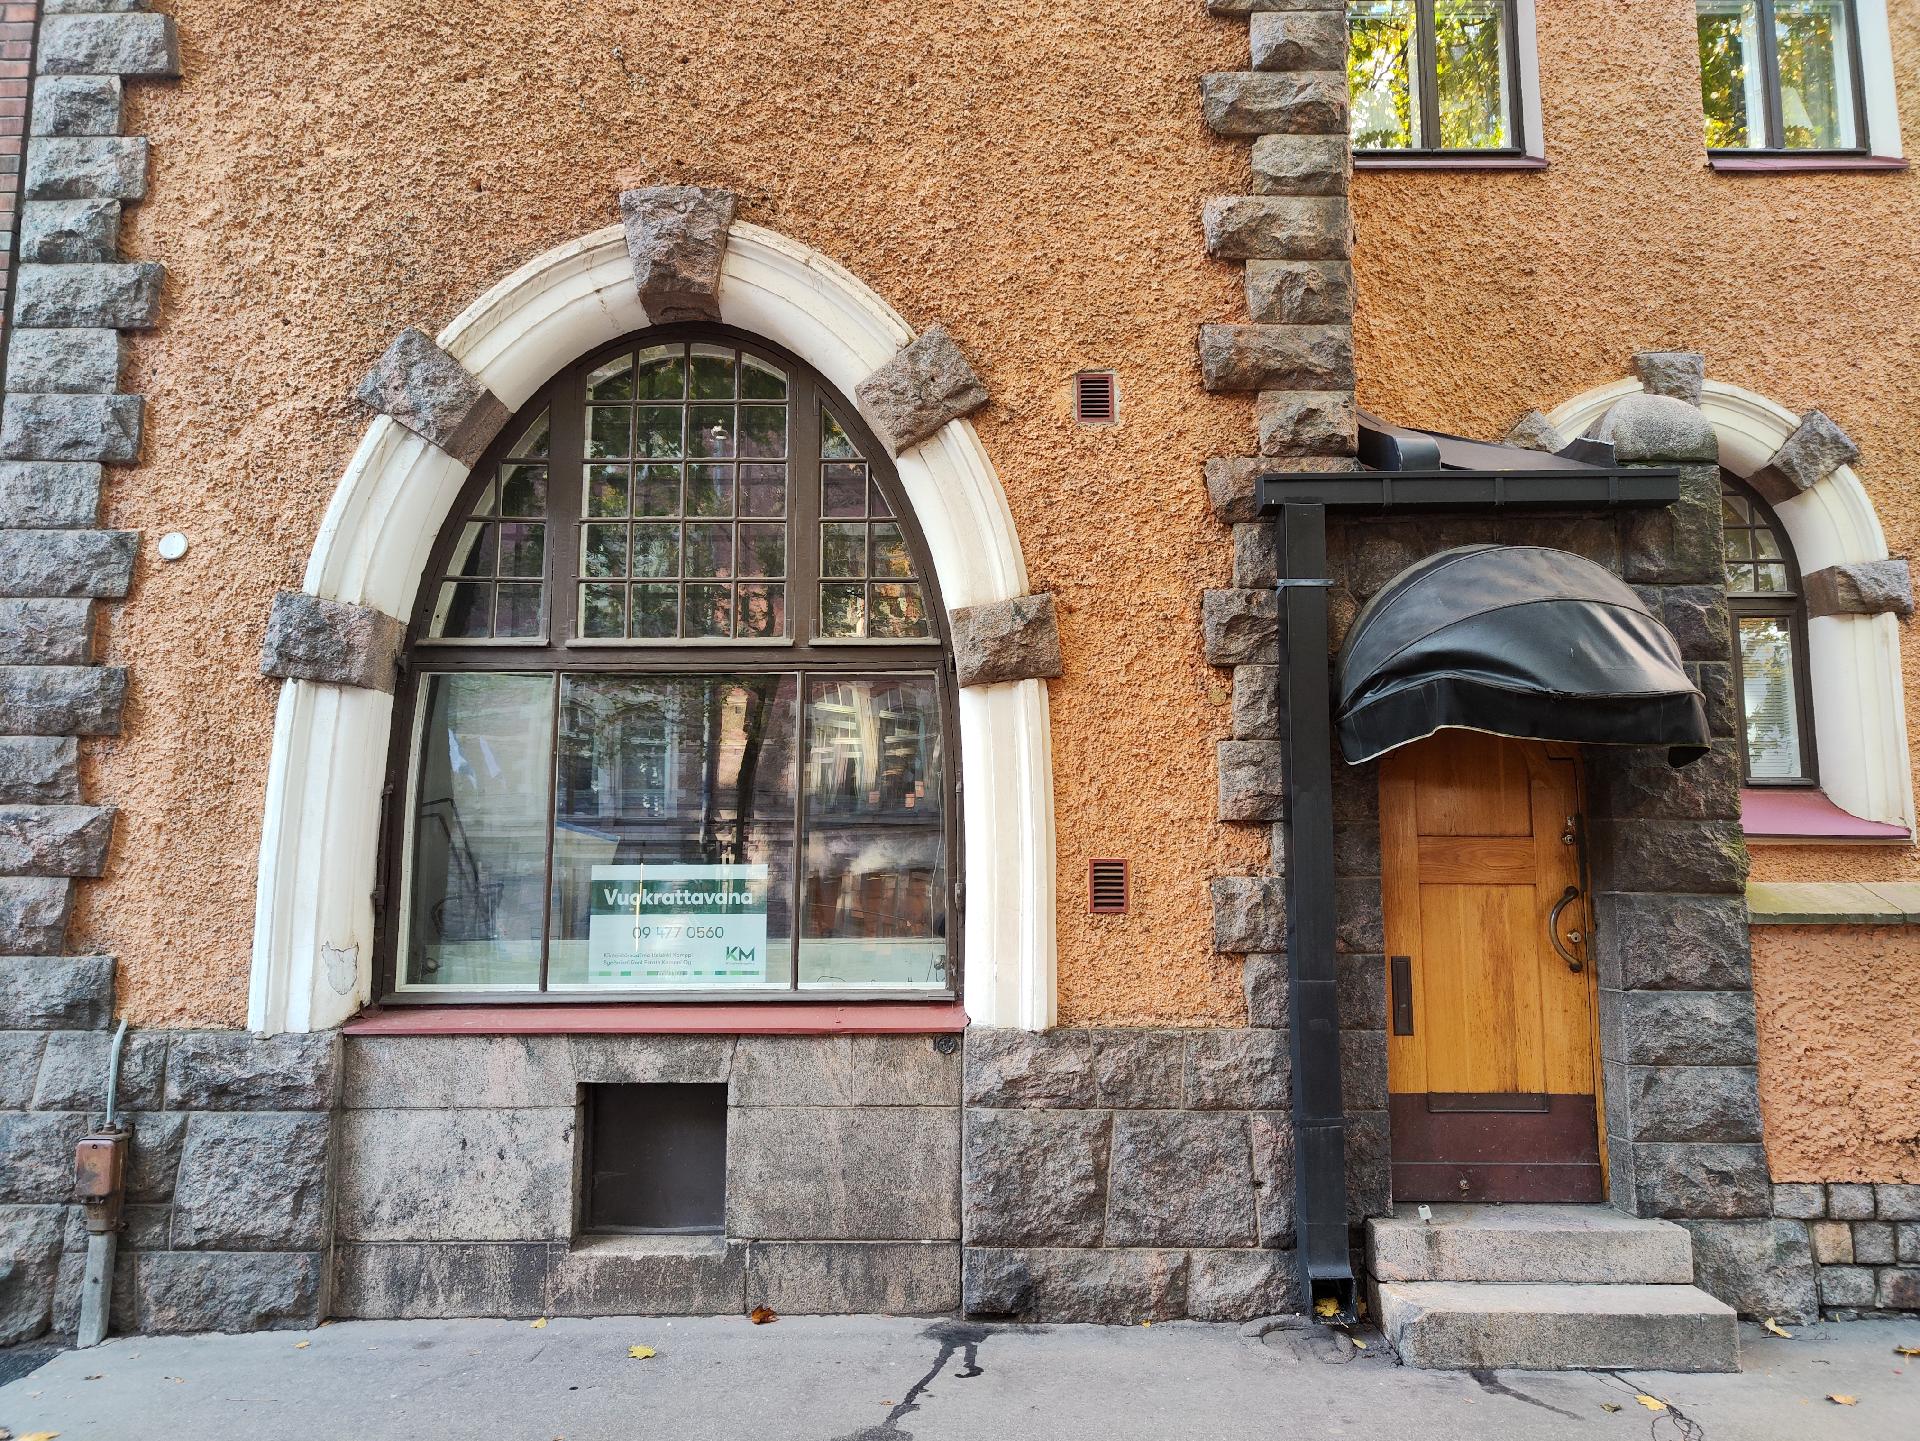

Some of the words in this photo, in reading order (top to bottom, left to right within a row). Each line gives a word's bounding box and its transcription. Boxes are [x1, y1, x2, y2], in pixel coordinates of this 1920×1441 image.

[603, 888, 753, 906] Vuokrattavana
[632, 926, 650, 939] 09
[656, 926, 682, 939] 477
[686, 926, 724, 939] 0560
[726, 946, 755, 961] KM
